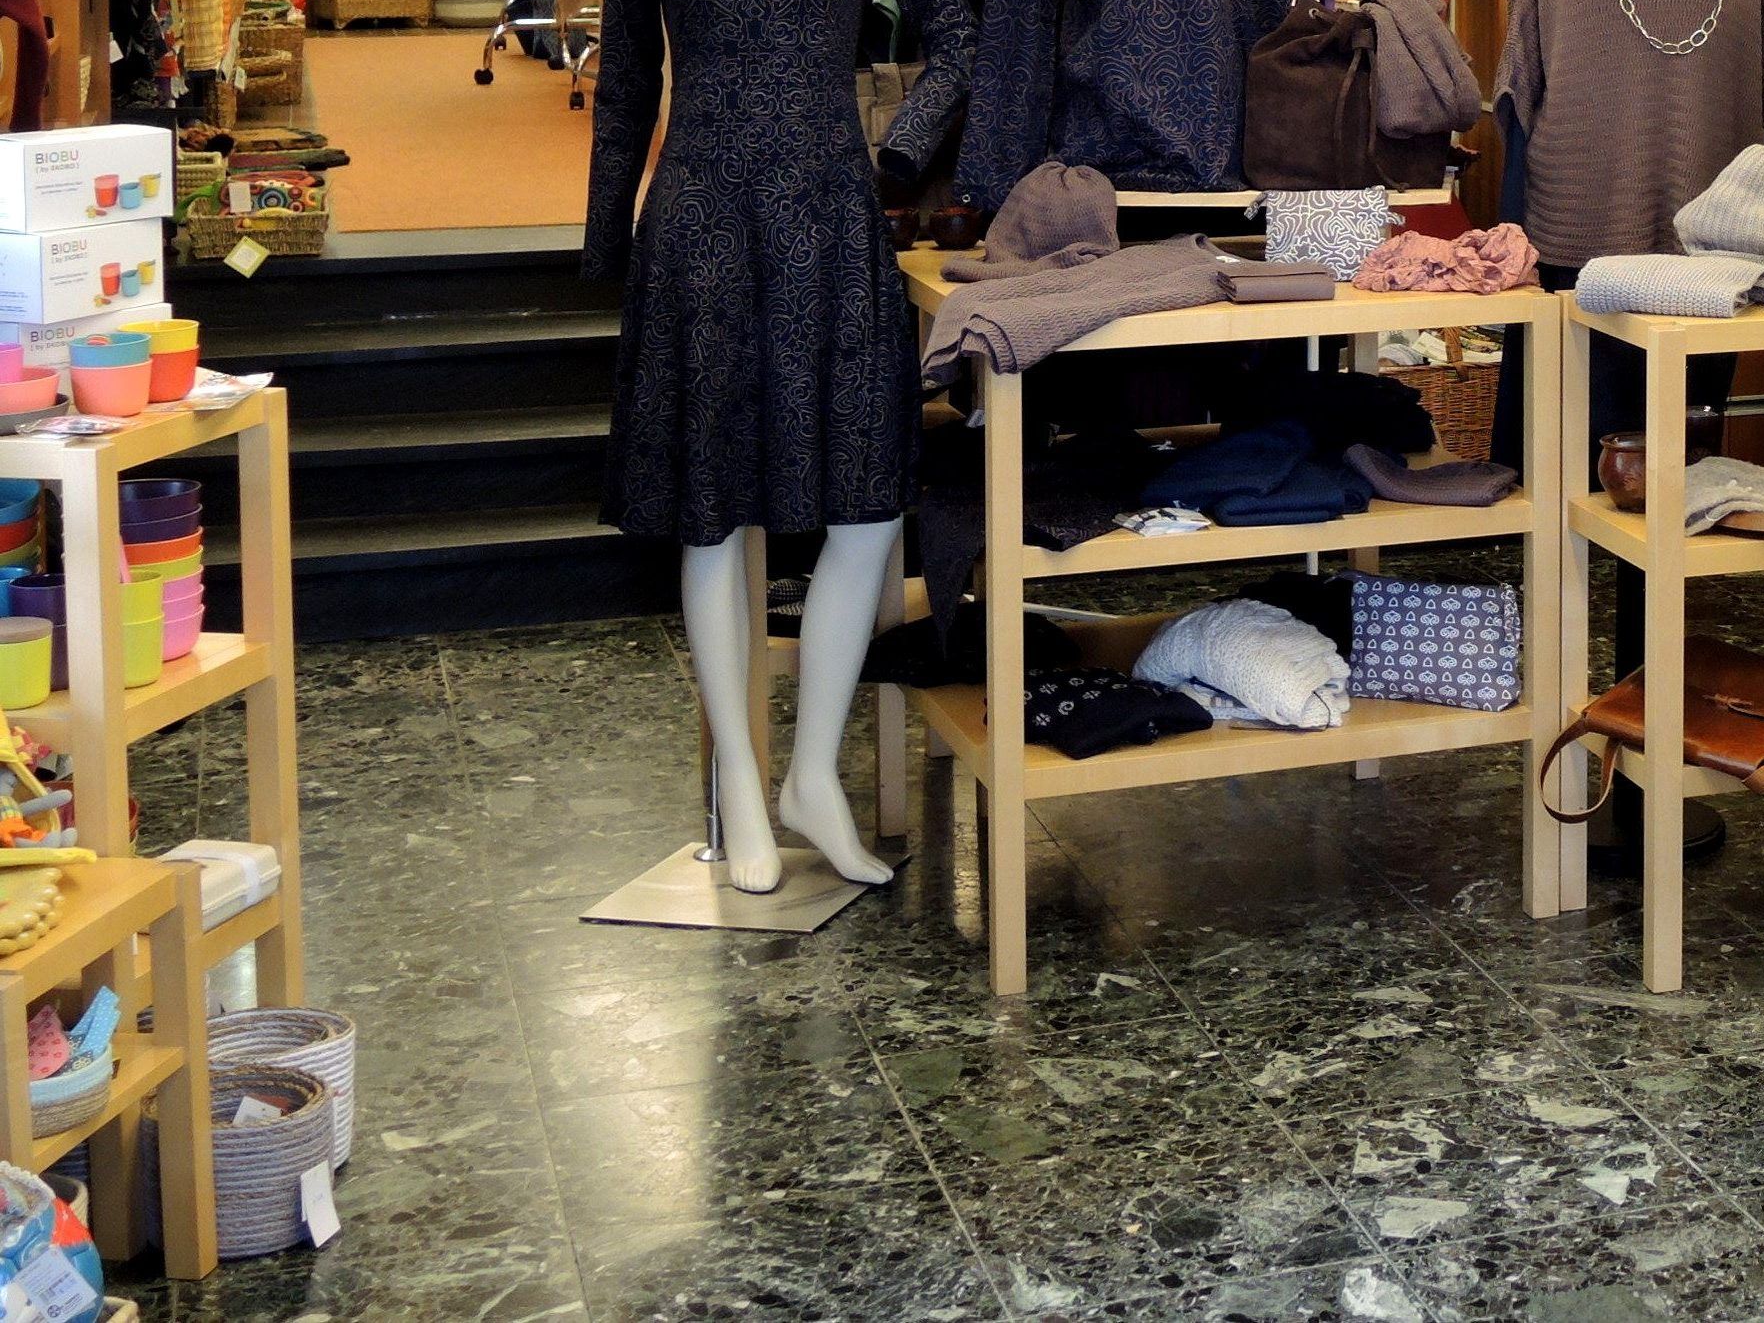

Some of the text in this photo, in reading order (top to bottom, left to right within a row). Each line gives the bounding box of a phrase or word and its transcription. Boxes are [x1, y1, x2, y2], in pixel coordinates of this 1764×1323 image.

[35, 150, 79, 165] BIOBU
[51, 239, 88, 256] BIOBU
[30, 326, 75, 343] BIOBU
